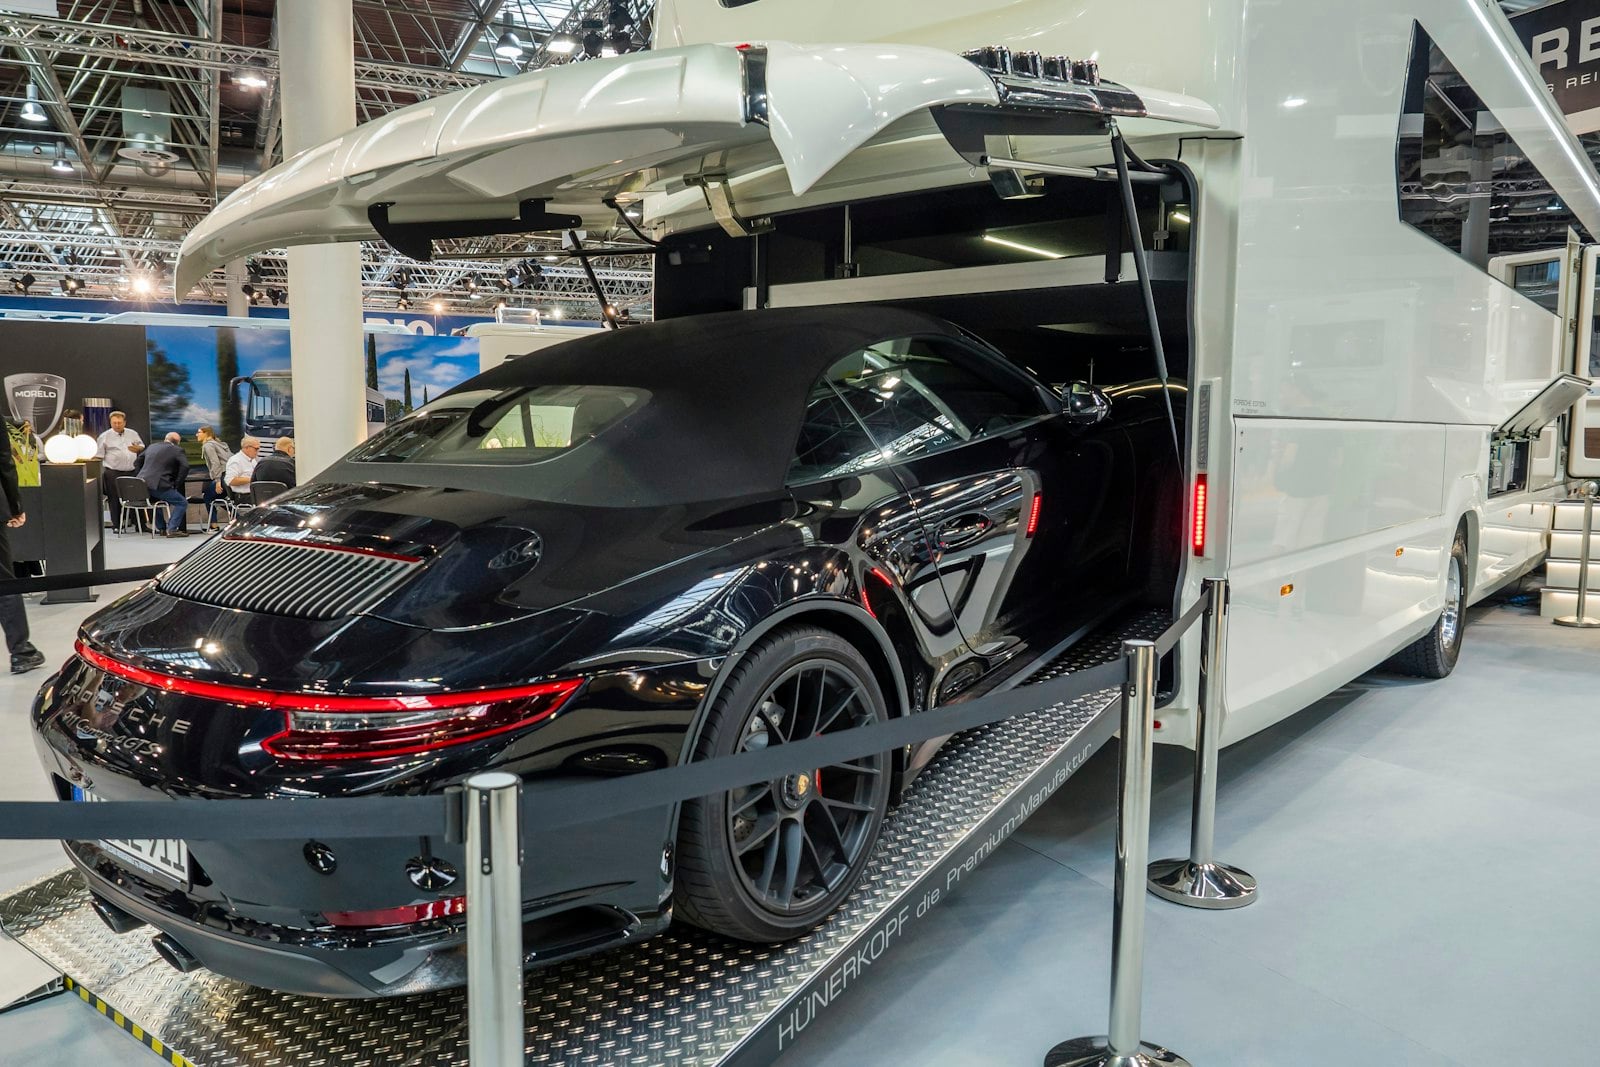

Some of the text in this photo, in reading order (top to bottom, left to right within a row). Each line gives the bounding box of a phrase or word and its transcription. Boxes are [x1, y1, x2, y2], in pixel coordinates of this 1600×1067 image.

[15, 390, 57, 399] MORELO
[66, 684, 191, 734] PORSCHE
[778, 743, 1092, 1051] HÜNERKOPF die Premium-Manufaktur
